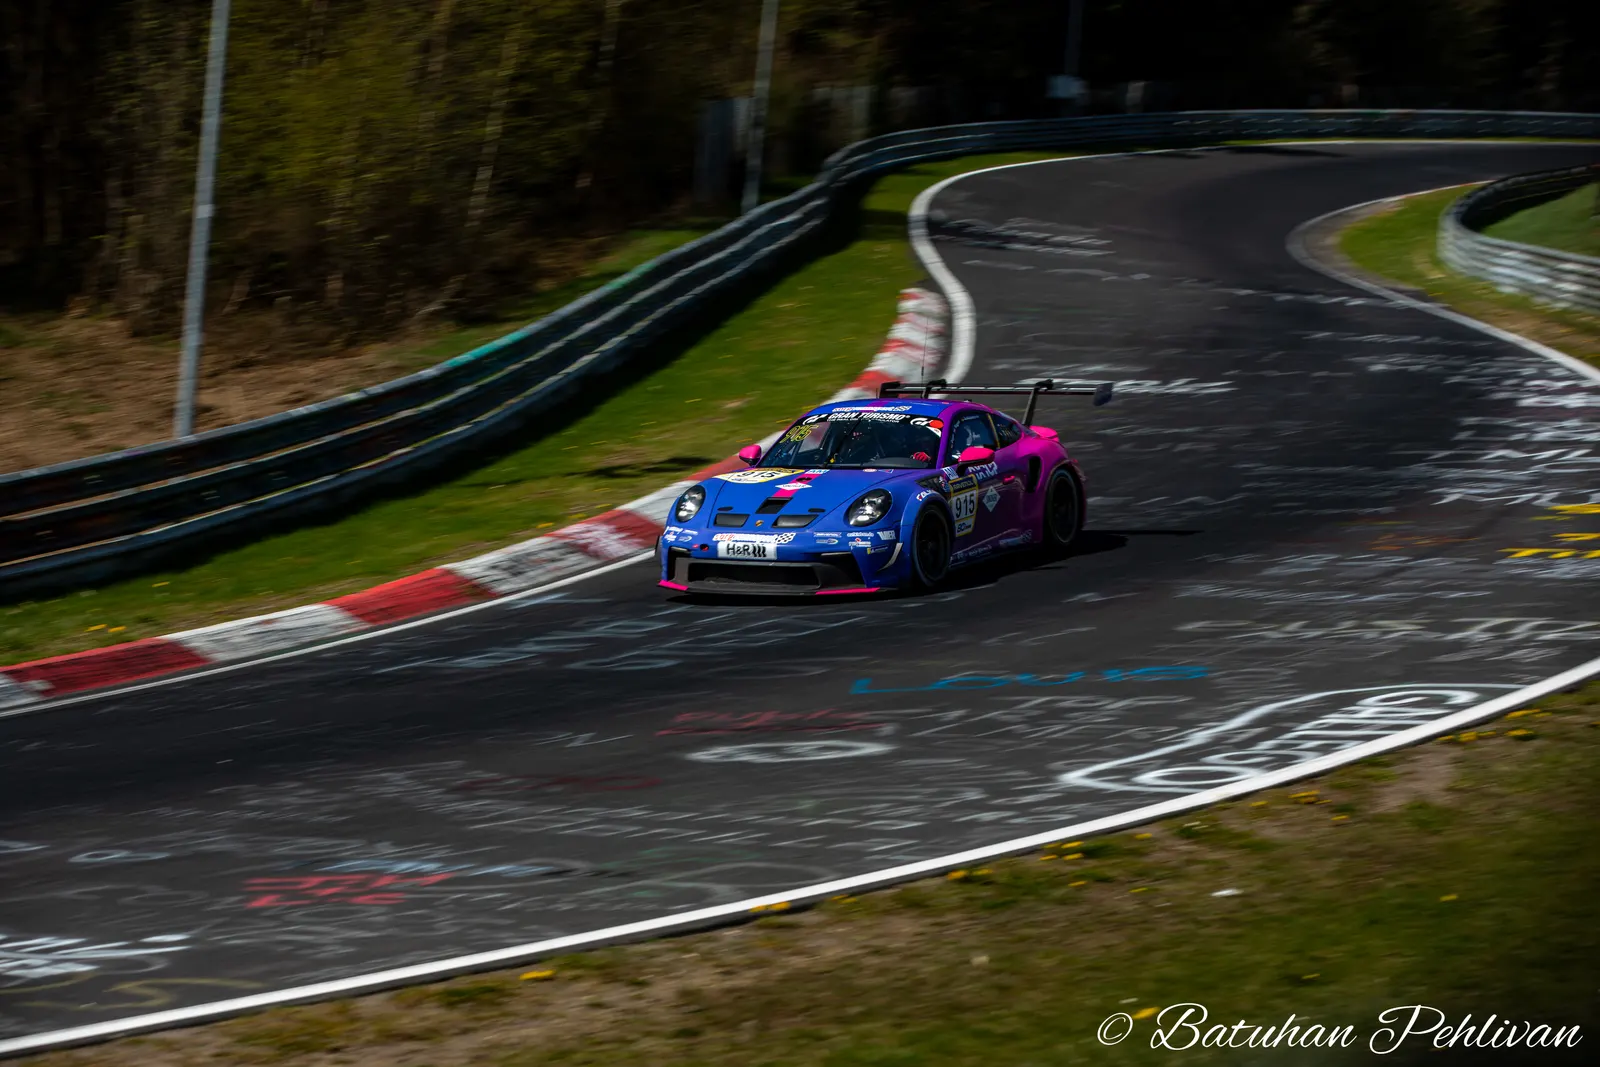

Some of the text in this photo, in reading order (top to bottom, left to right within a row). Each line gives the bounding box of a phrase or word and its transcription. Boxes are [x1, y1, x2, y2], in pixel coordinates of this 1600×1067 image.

[828, 412, 858, 420] GRAN
[858, 412, 906, 421] TURISMO
[955, 493, 975, 518] 915
[850, 665, 1208, 695] LOUIS
